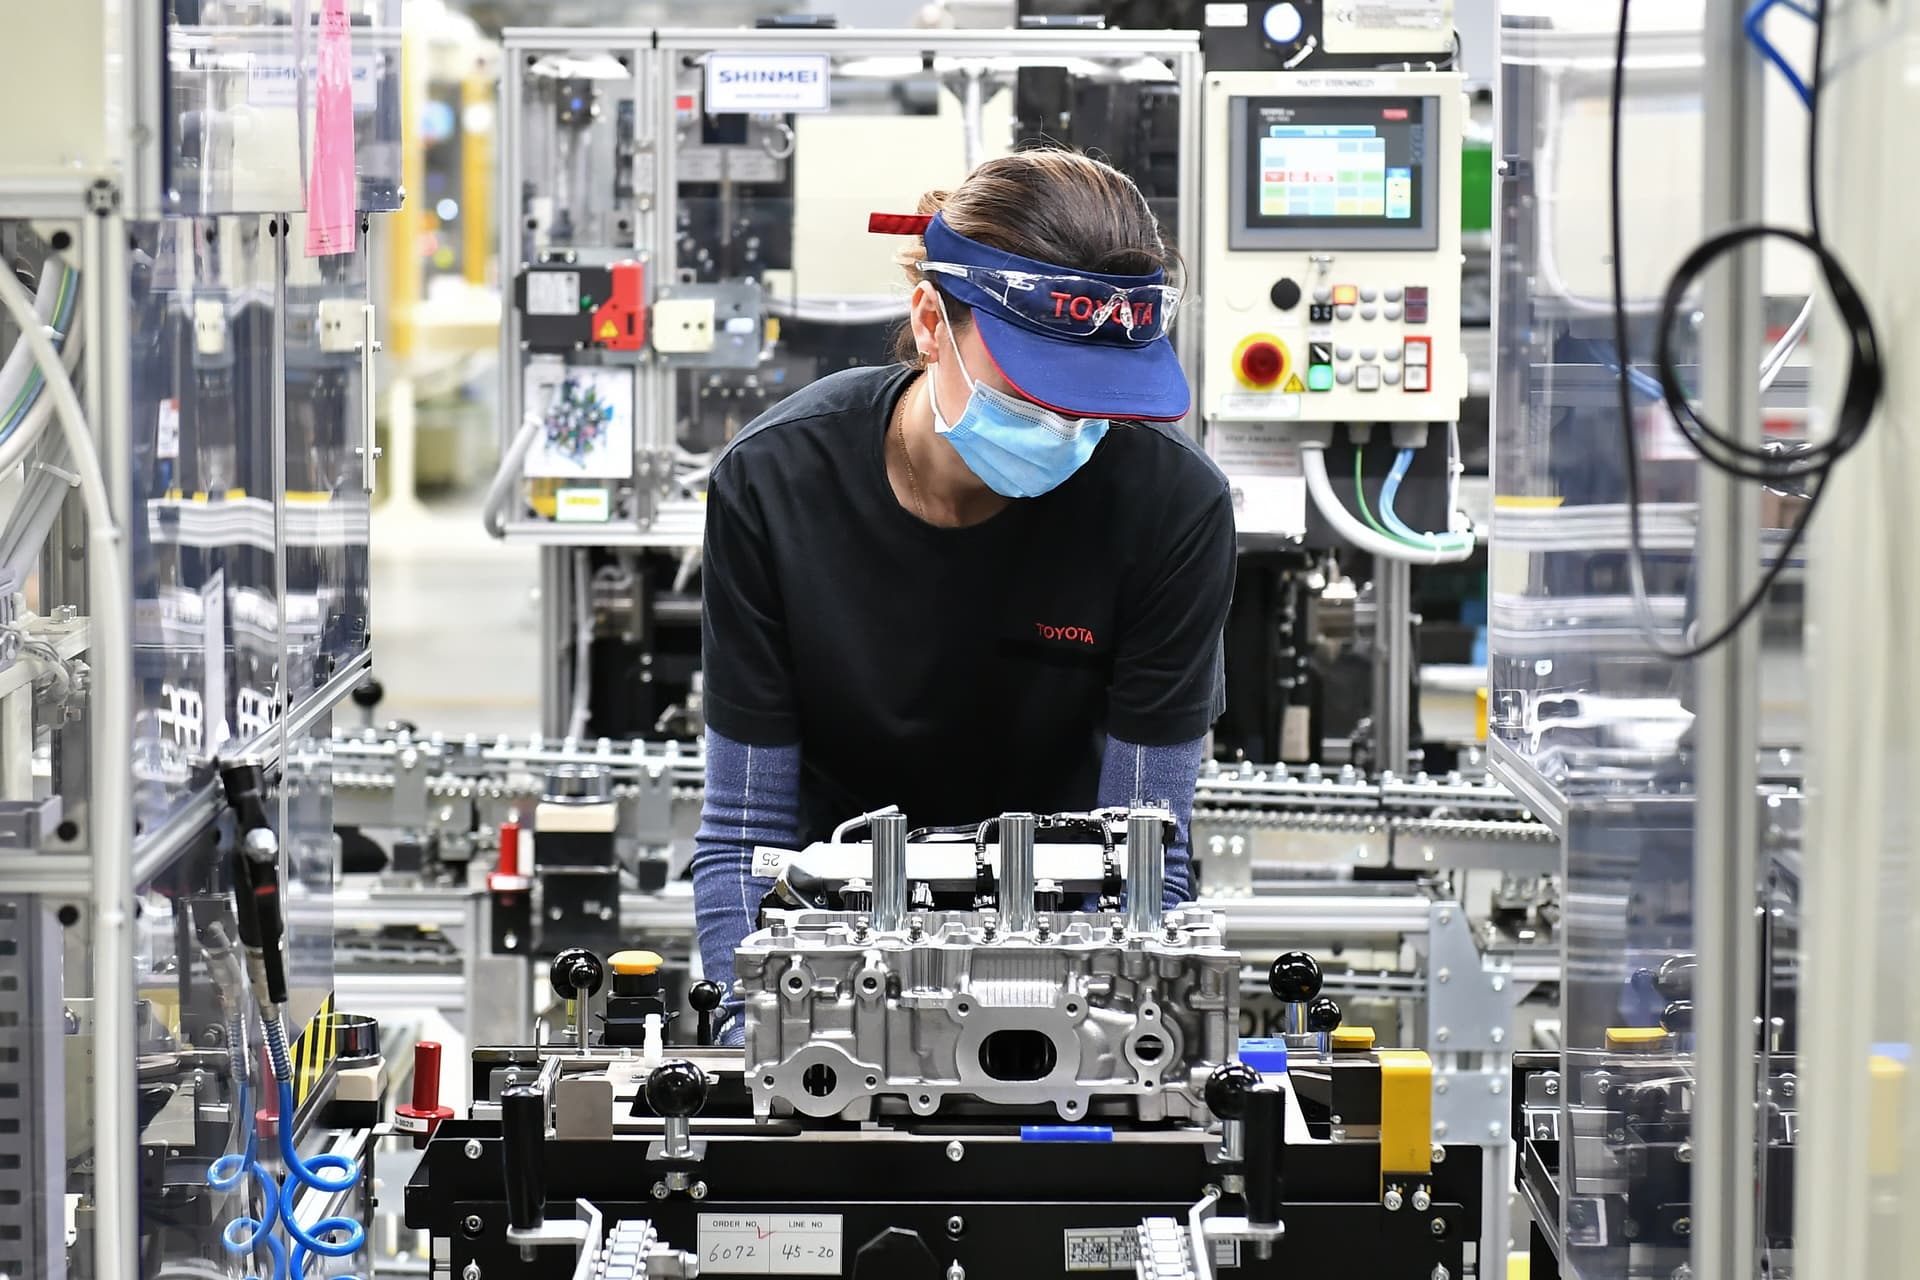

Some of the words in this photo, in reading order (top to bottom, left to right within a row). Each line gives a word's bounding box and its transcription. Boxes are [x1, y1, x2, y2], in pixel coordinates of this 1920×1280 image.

[719, 70, 818, 83] SHINMEI
[1035, 622, 1094, 645] TOYOTA
[762, 852, 781, 867] 25
[712, 1220, 740, 1228] ORDER
[709, 1243, 756, 1262] 6072
